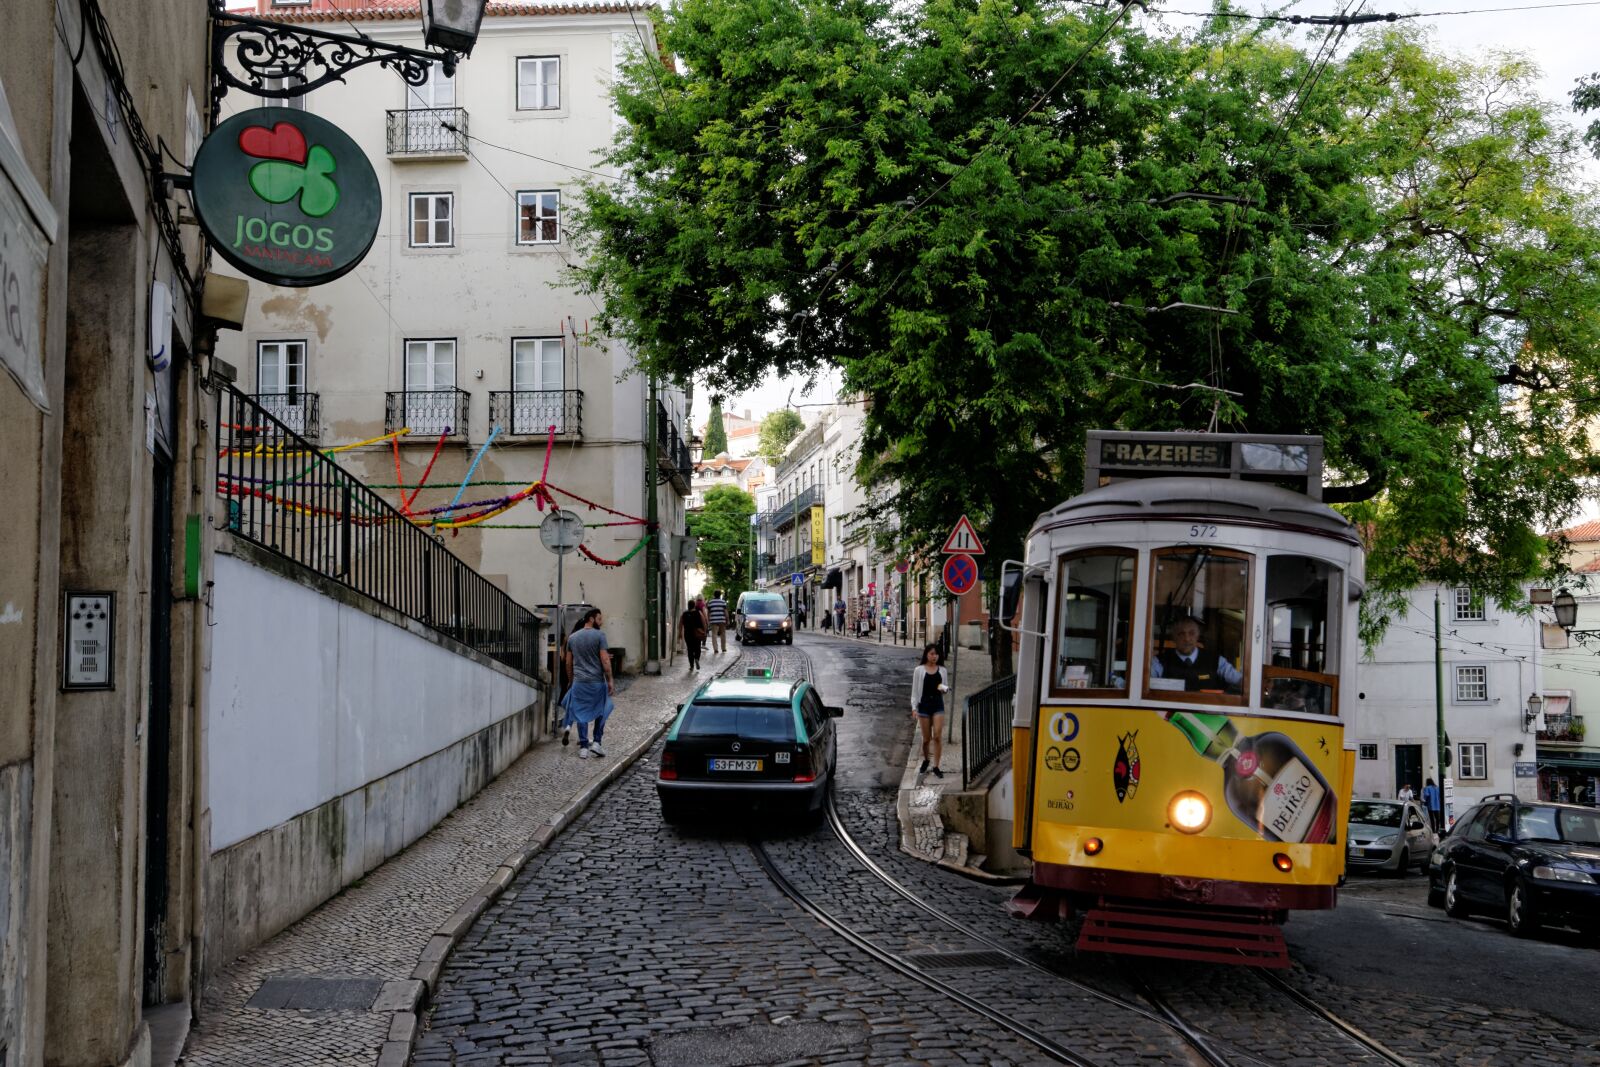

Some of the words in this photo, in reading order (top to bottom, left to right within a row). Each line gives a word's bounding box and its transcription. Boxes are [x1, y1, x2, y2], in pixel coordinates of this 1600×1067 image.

[232, 215, 334, 252] JOGOS
[1103, 442, 1218, 463] PRAZERES
[1189, 525, 1218, 538] 572
[1272, 776, 1311, 832] BEIRÃO
